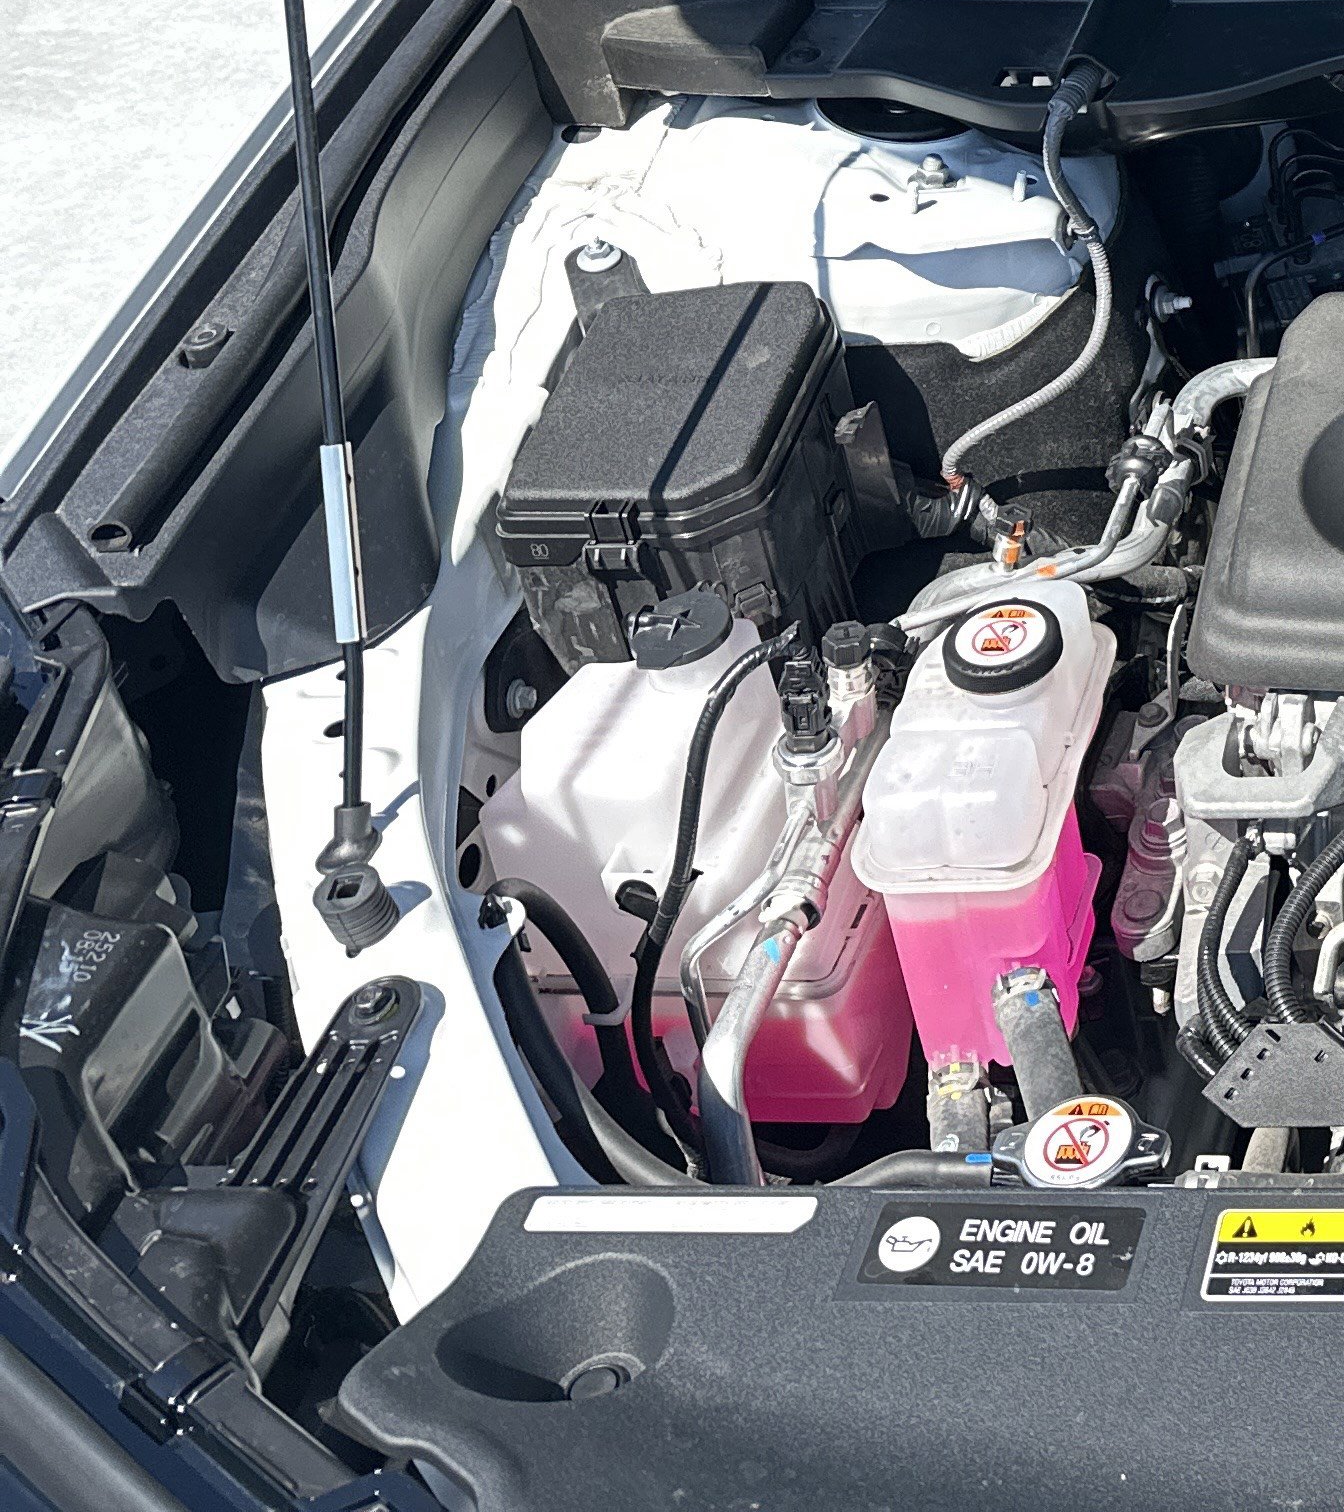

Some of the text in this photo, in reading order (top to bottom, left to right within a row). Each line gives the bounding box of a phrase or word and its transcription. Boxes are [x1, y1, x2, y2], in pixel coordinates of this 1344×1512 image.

[959, 1218, 1110, 1245] ENGINE OIL
[950, 1249, 1095, 1276] SAE 0W-8
[1255, 1278, 1279, 1286] MOTOR
